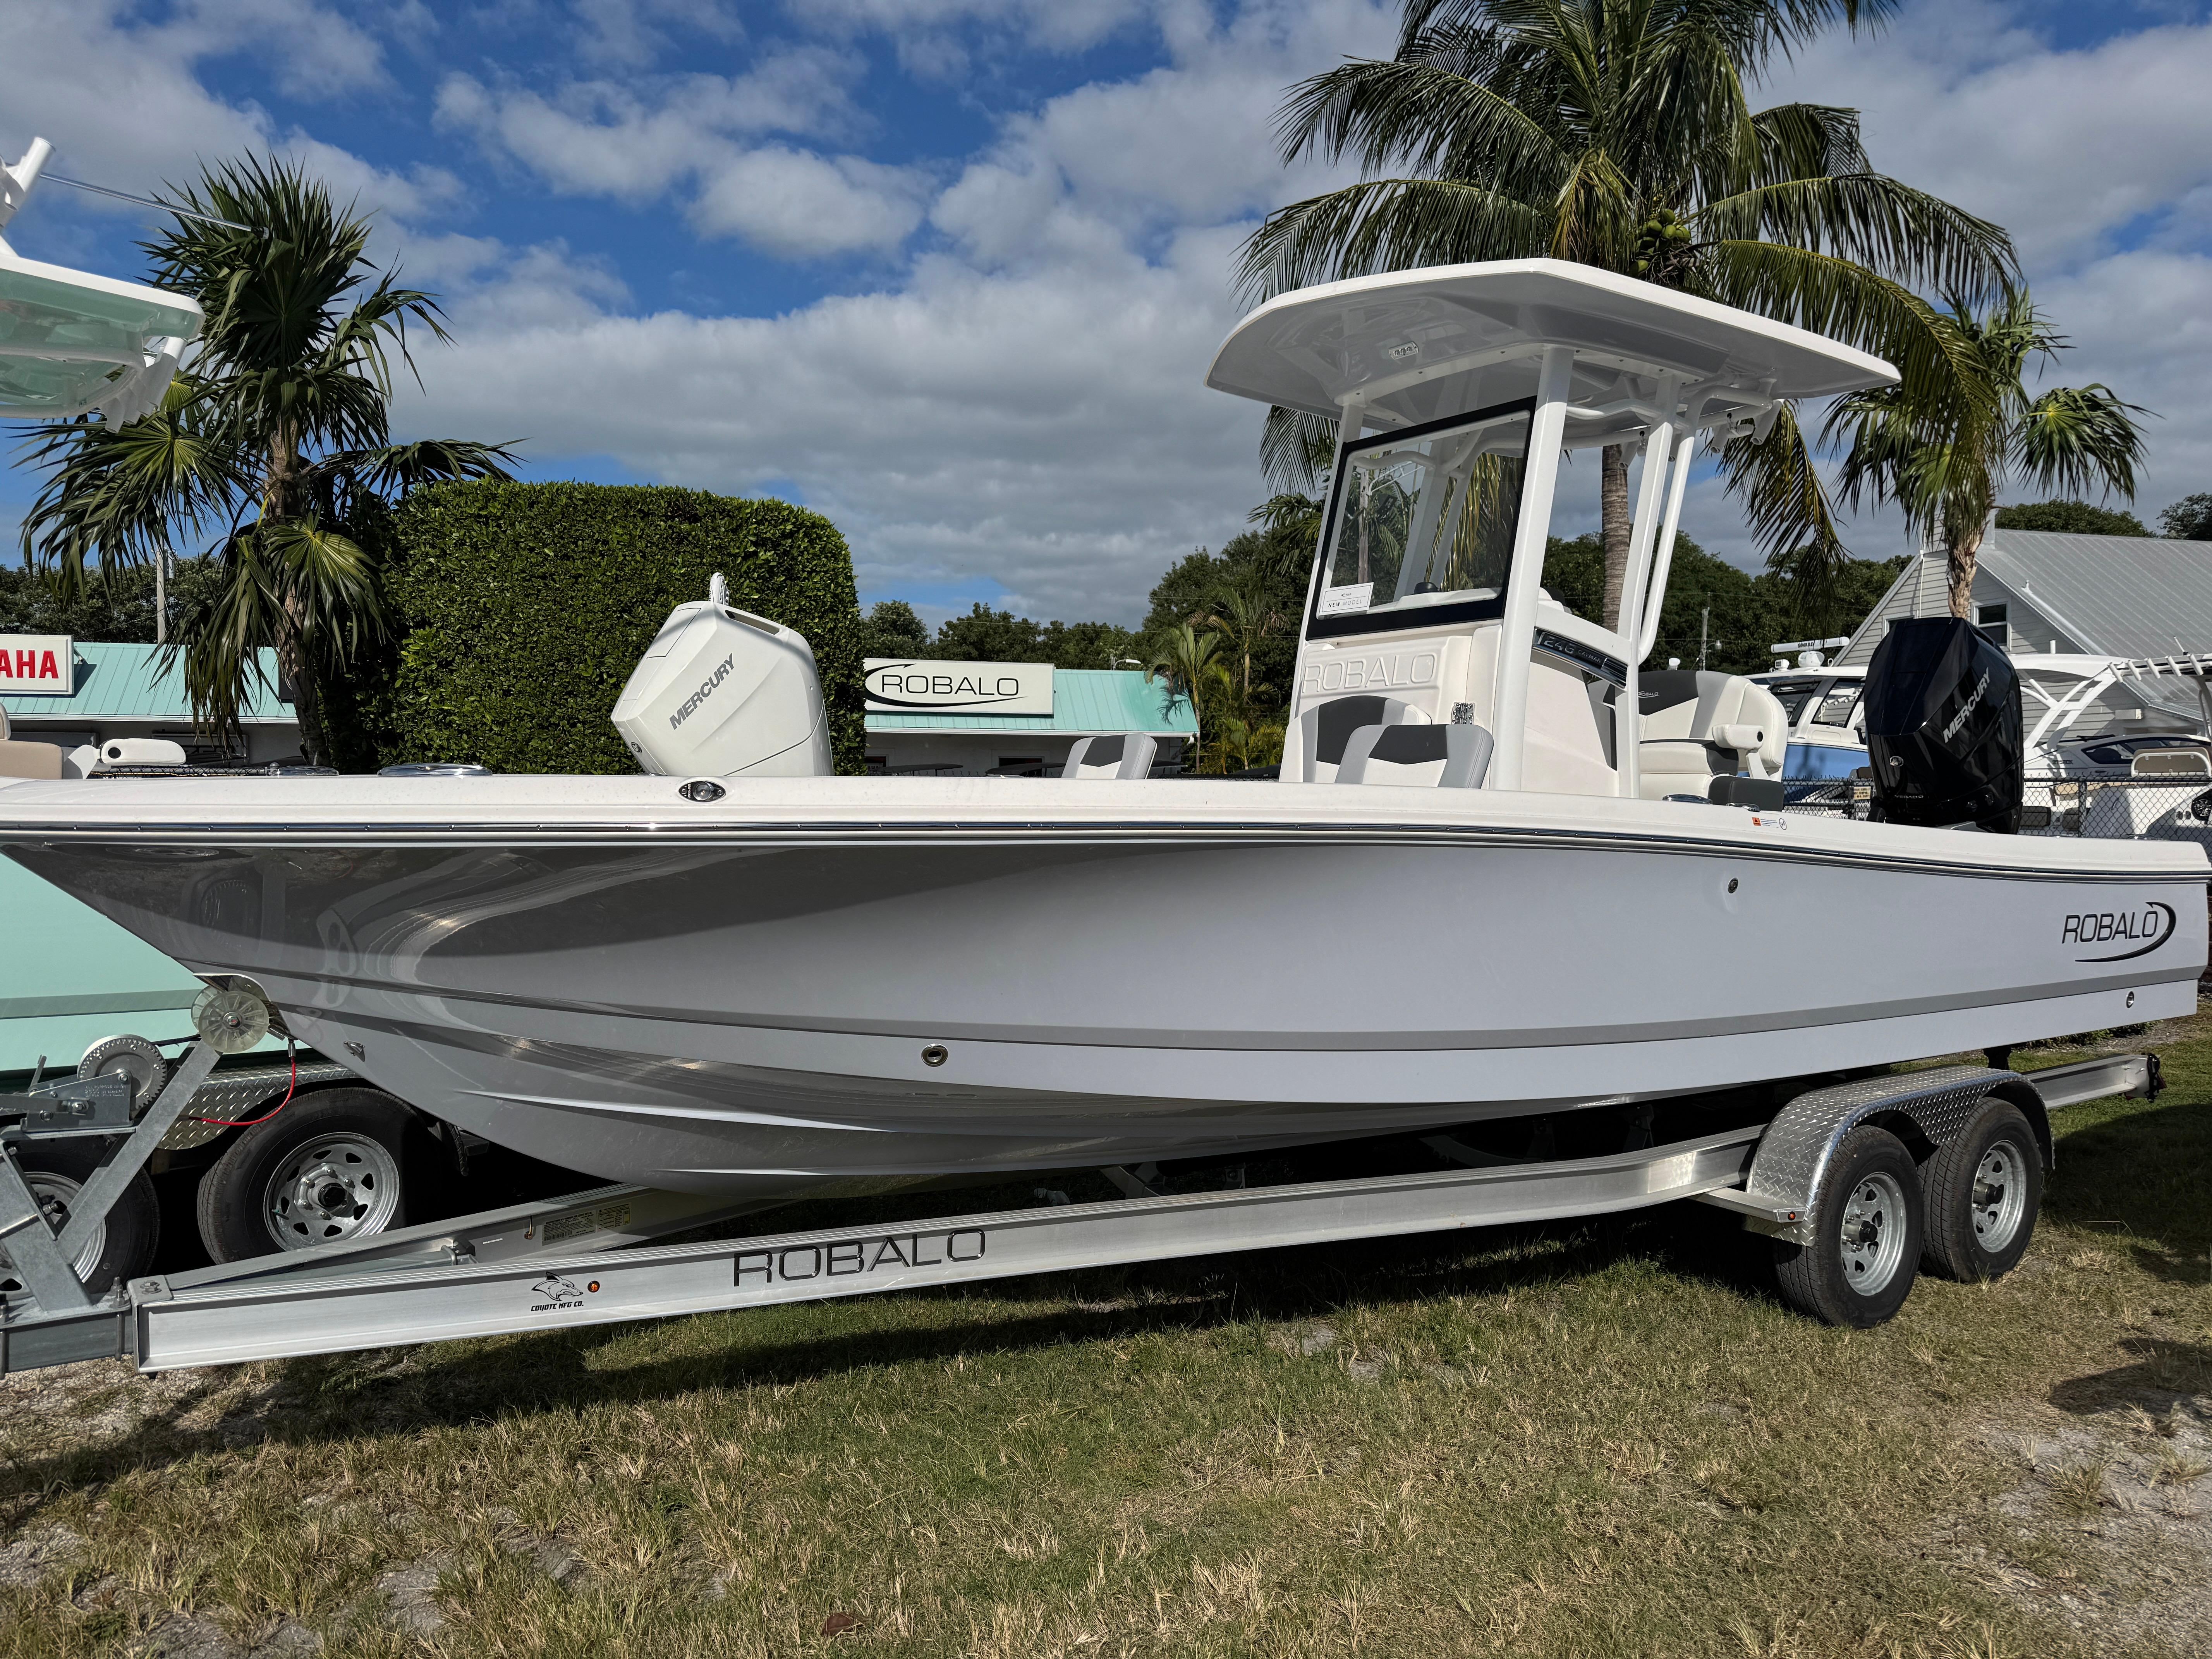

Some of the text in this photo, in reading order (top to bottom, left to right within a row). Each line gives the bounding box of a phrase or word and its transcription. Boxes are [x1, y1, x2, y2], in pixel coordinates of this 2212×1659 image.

[669, 653, 735, 730] MERCURY
[881, 674, 1019, 696] ROBALO
[1302, 652, 1437, 694] ROBALO
[1943, 667, 1991, 744] MERCURY
[2061, 910, 2159, 944] ROBALO
[734, 1228, 986, 1287] ROBALO
[531, 1303, 558, 1312] COYOTE
